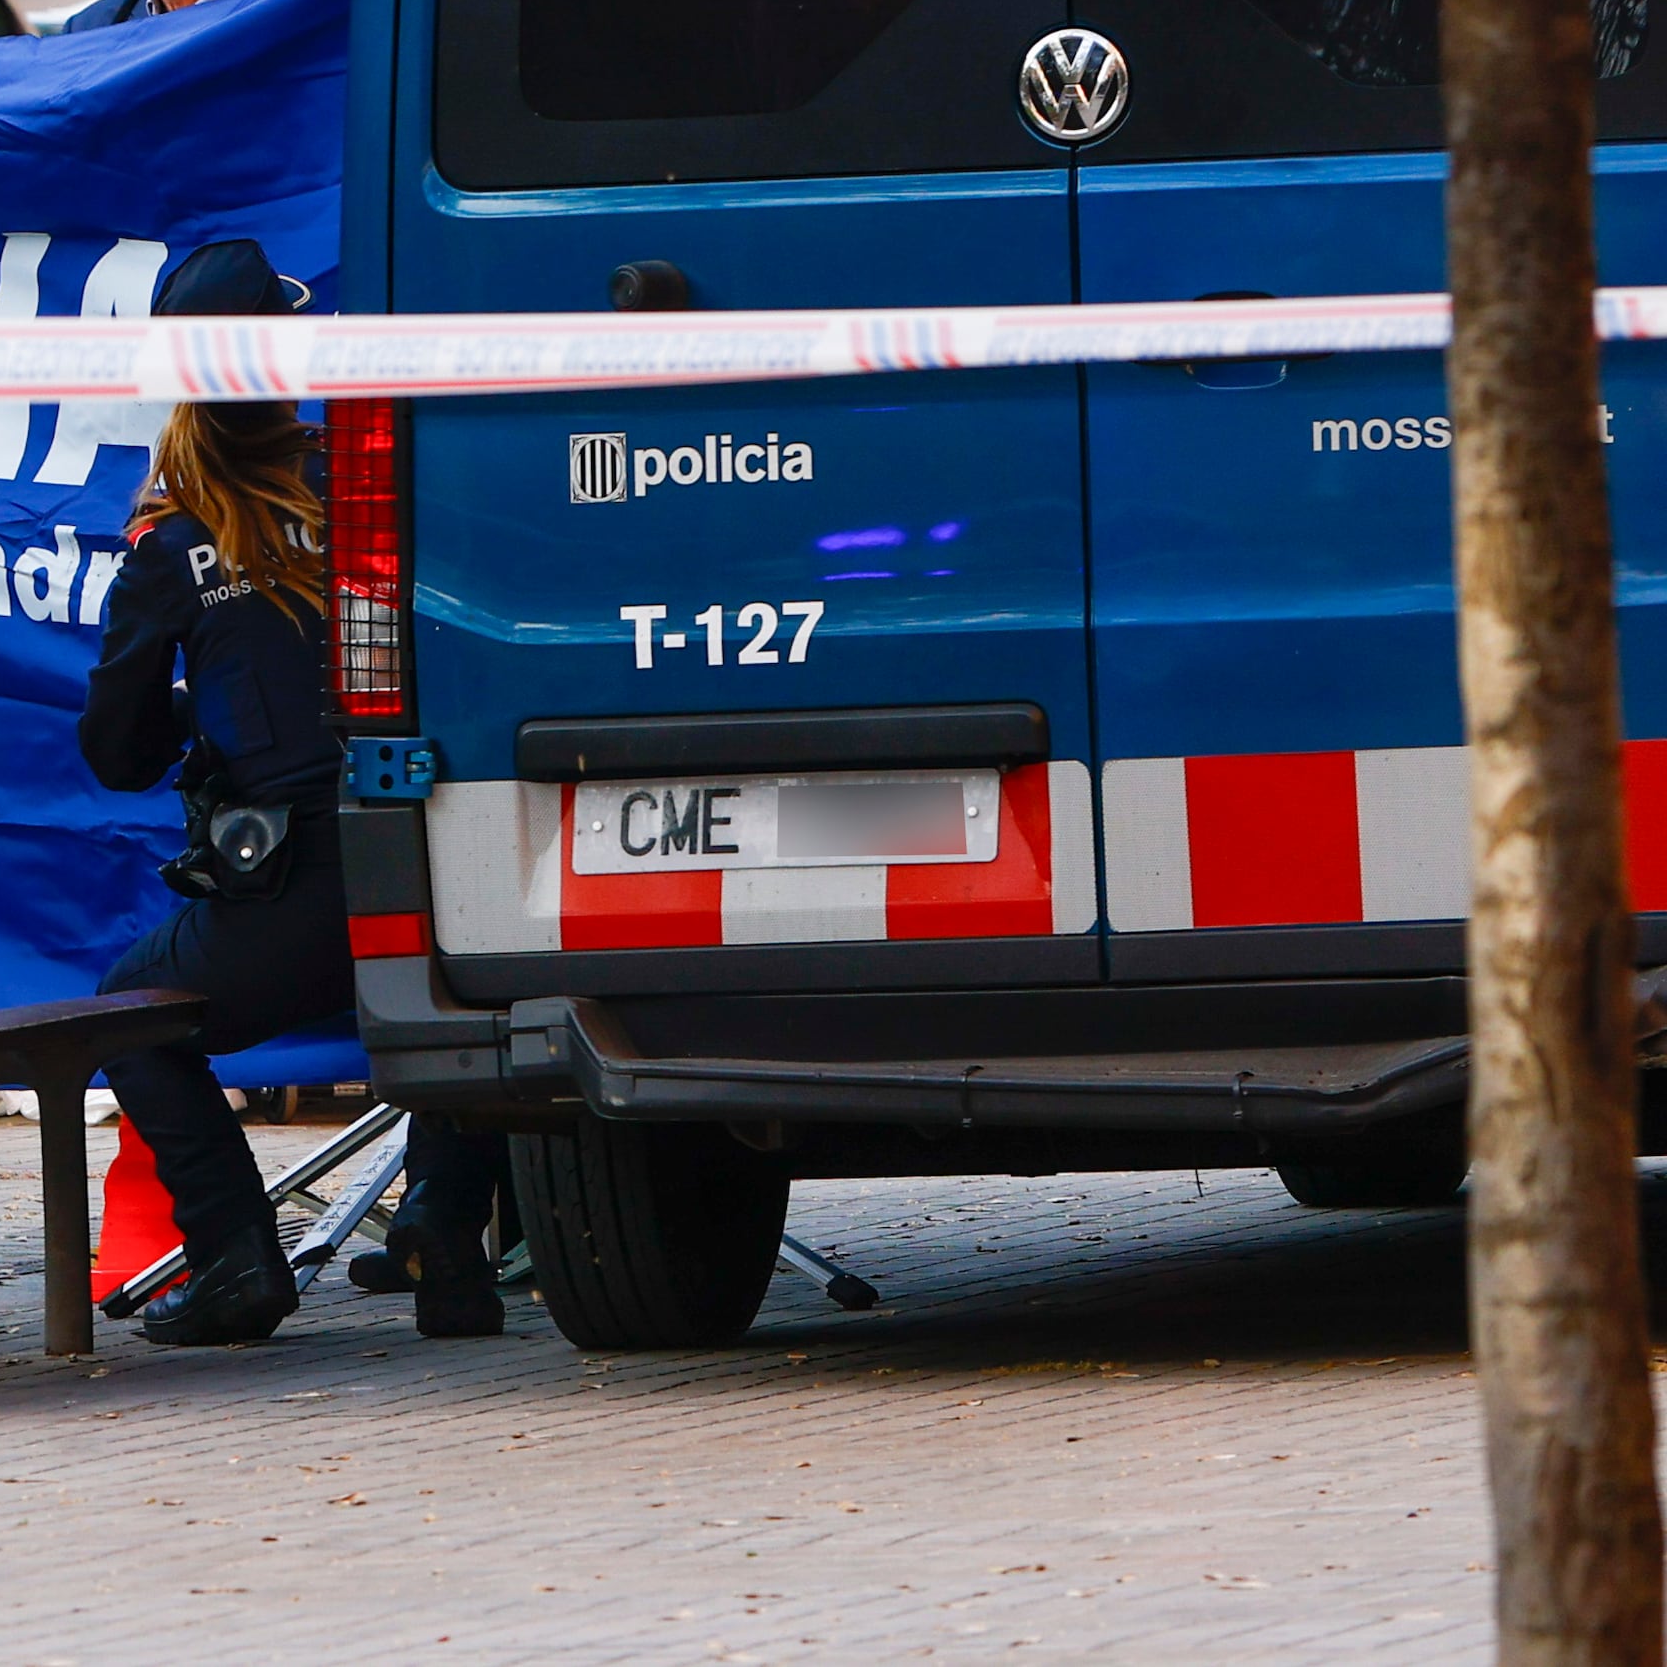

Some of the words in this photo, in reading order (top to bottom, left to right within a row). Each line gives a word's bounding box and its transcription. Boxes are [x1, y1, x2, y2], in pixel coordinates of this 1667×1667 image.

[633, 431, 814, 497] policia
[619, 600, 825, 670] T-127
[619, 787, 741, 857] CME
